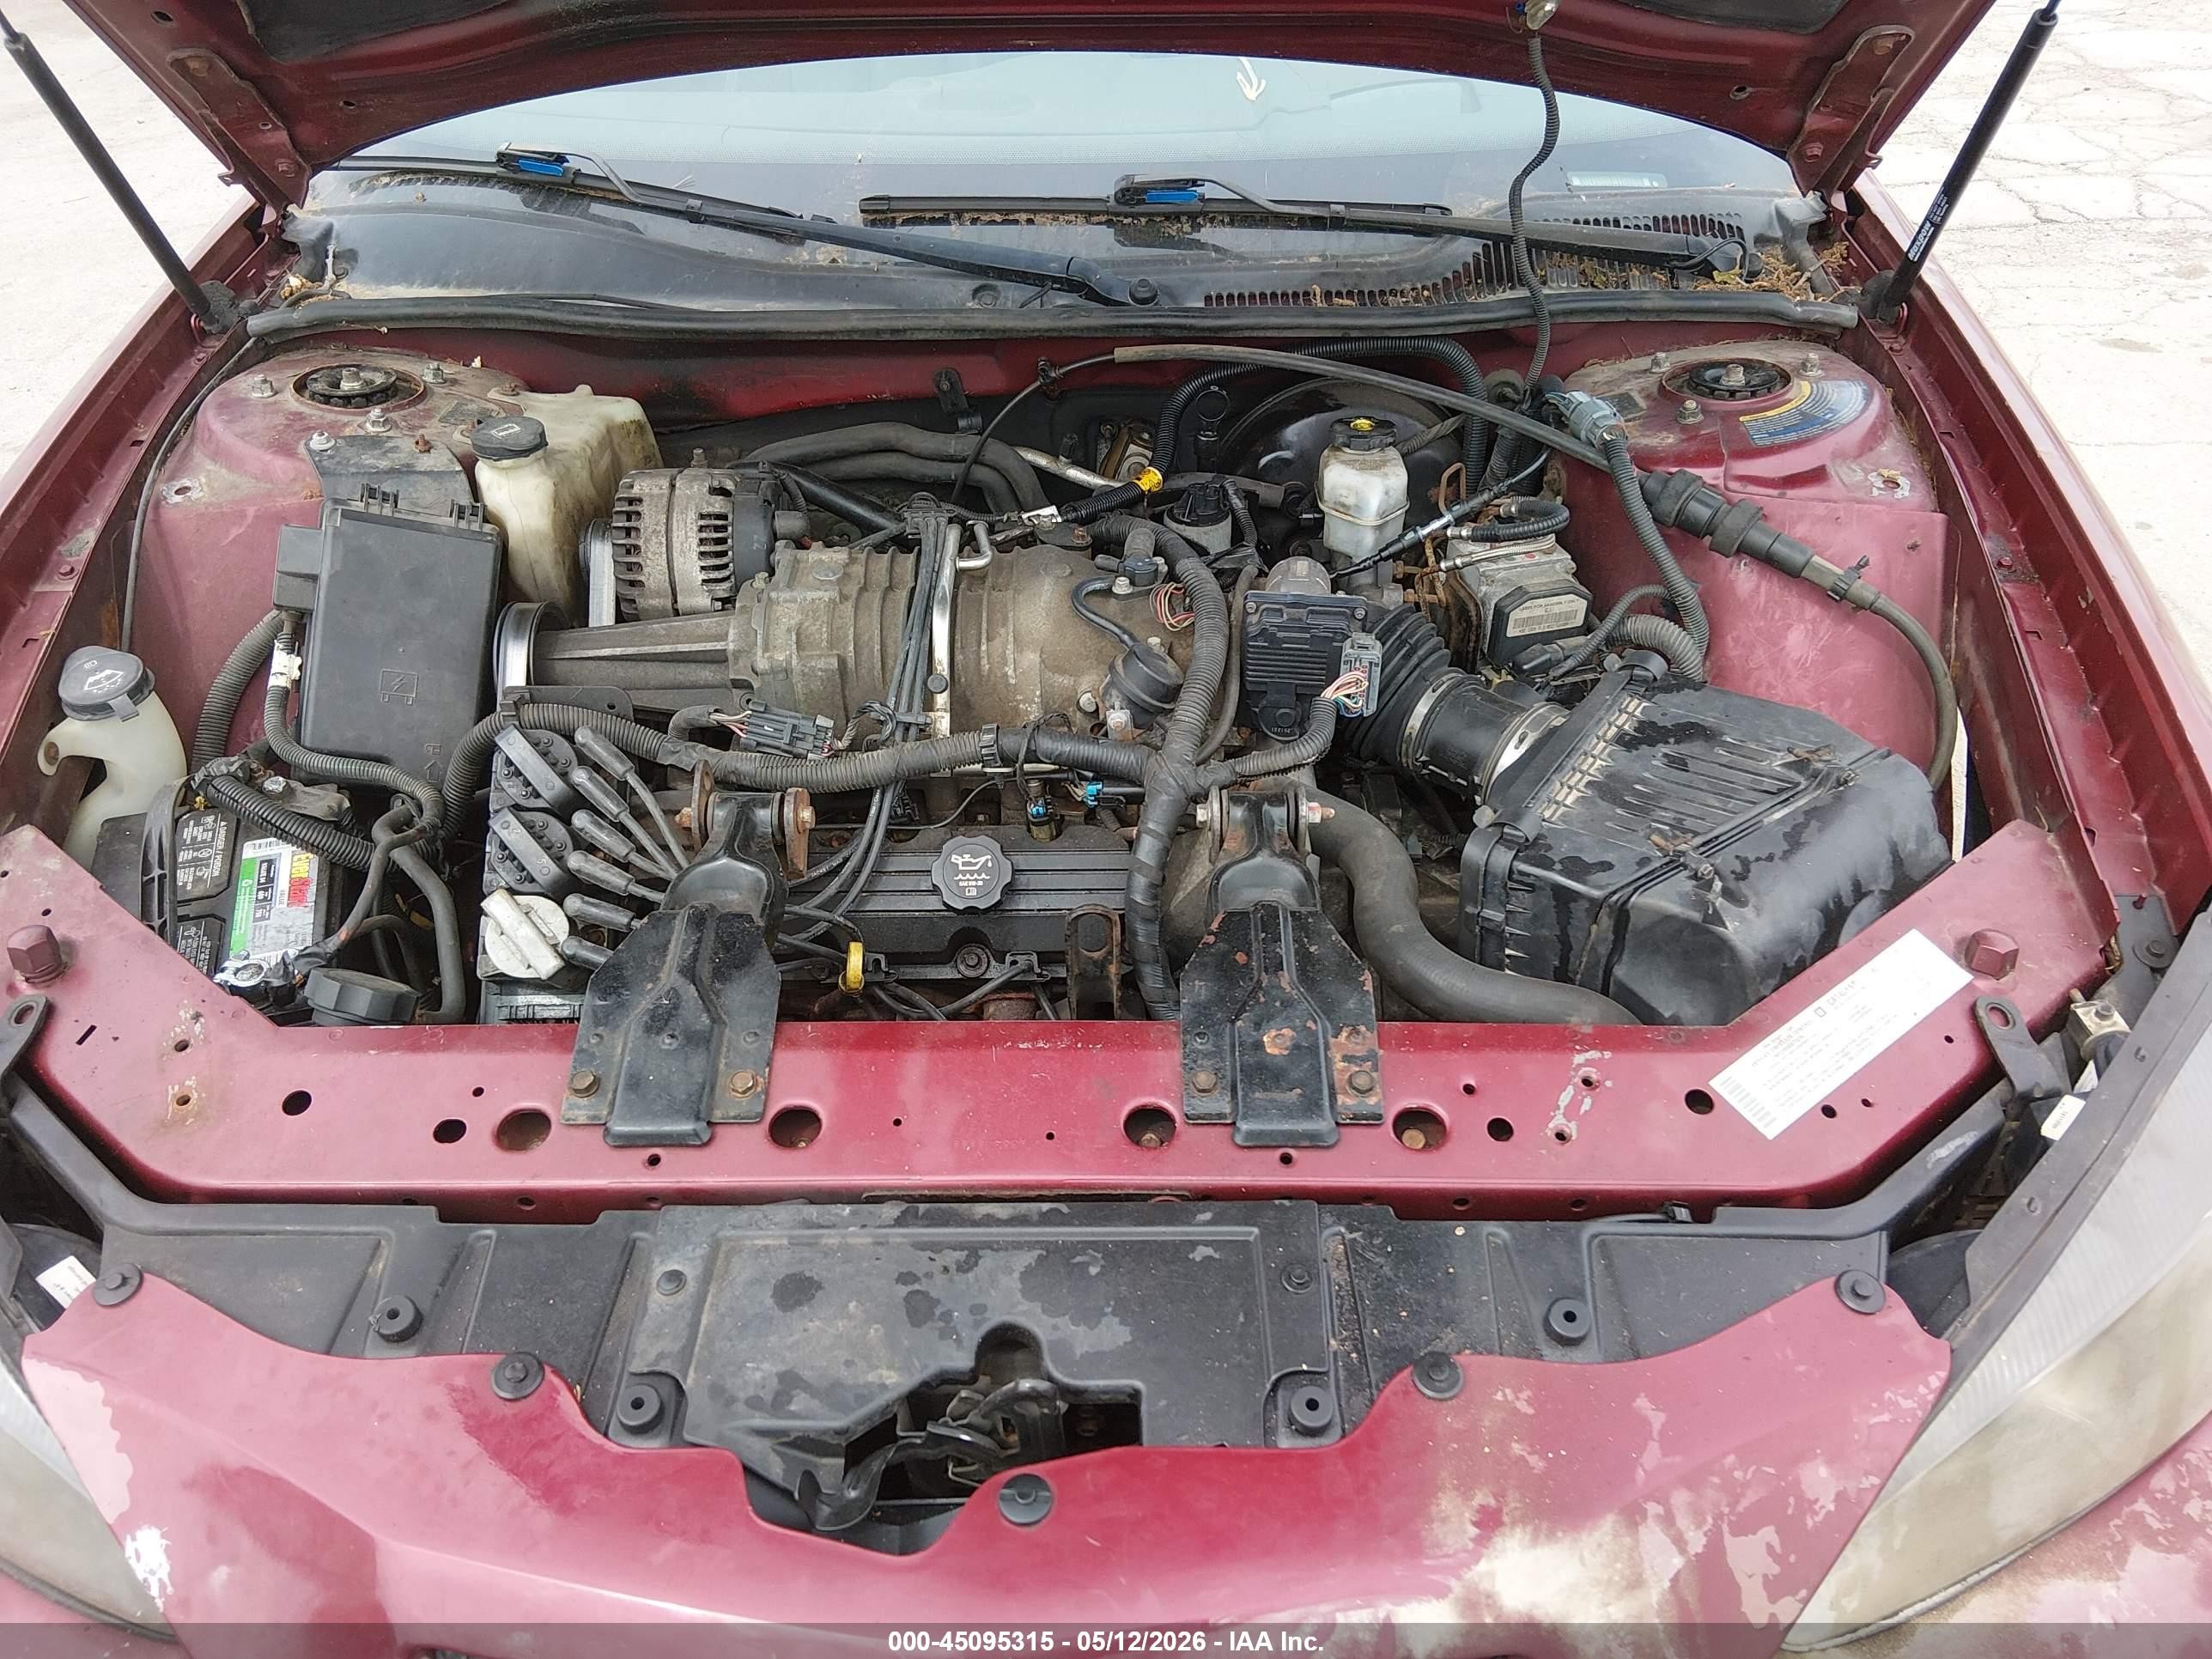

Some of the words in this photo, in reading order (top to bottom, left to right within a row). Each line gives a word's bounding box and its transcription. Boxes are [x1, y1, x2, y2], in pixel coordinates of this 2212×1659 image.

[1907, 220, 1931, 260] Maxpow
[216, 826, 228, 850] DANGER
[211, 854, 223, 877] POISON
